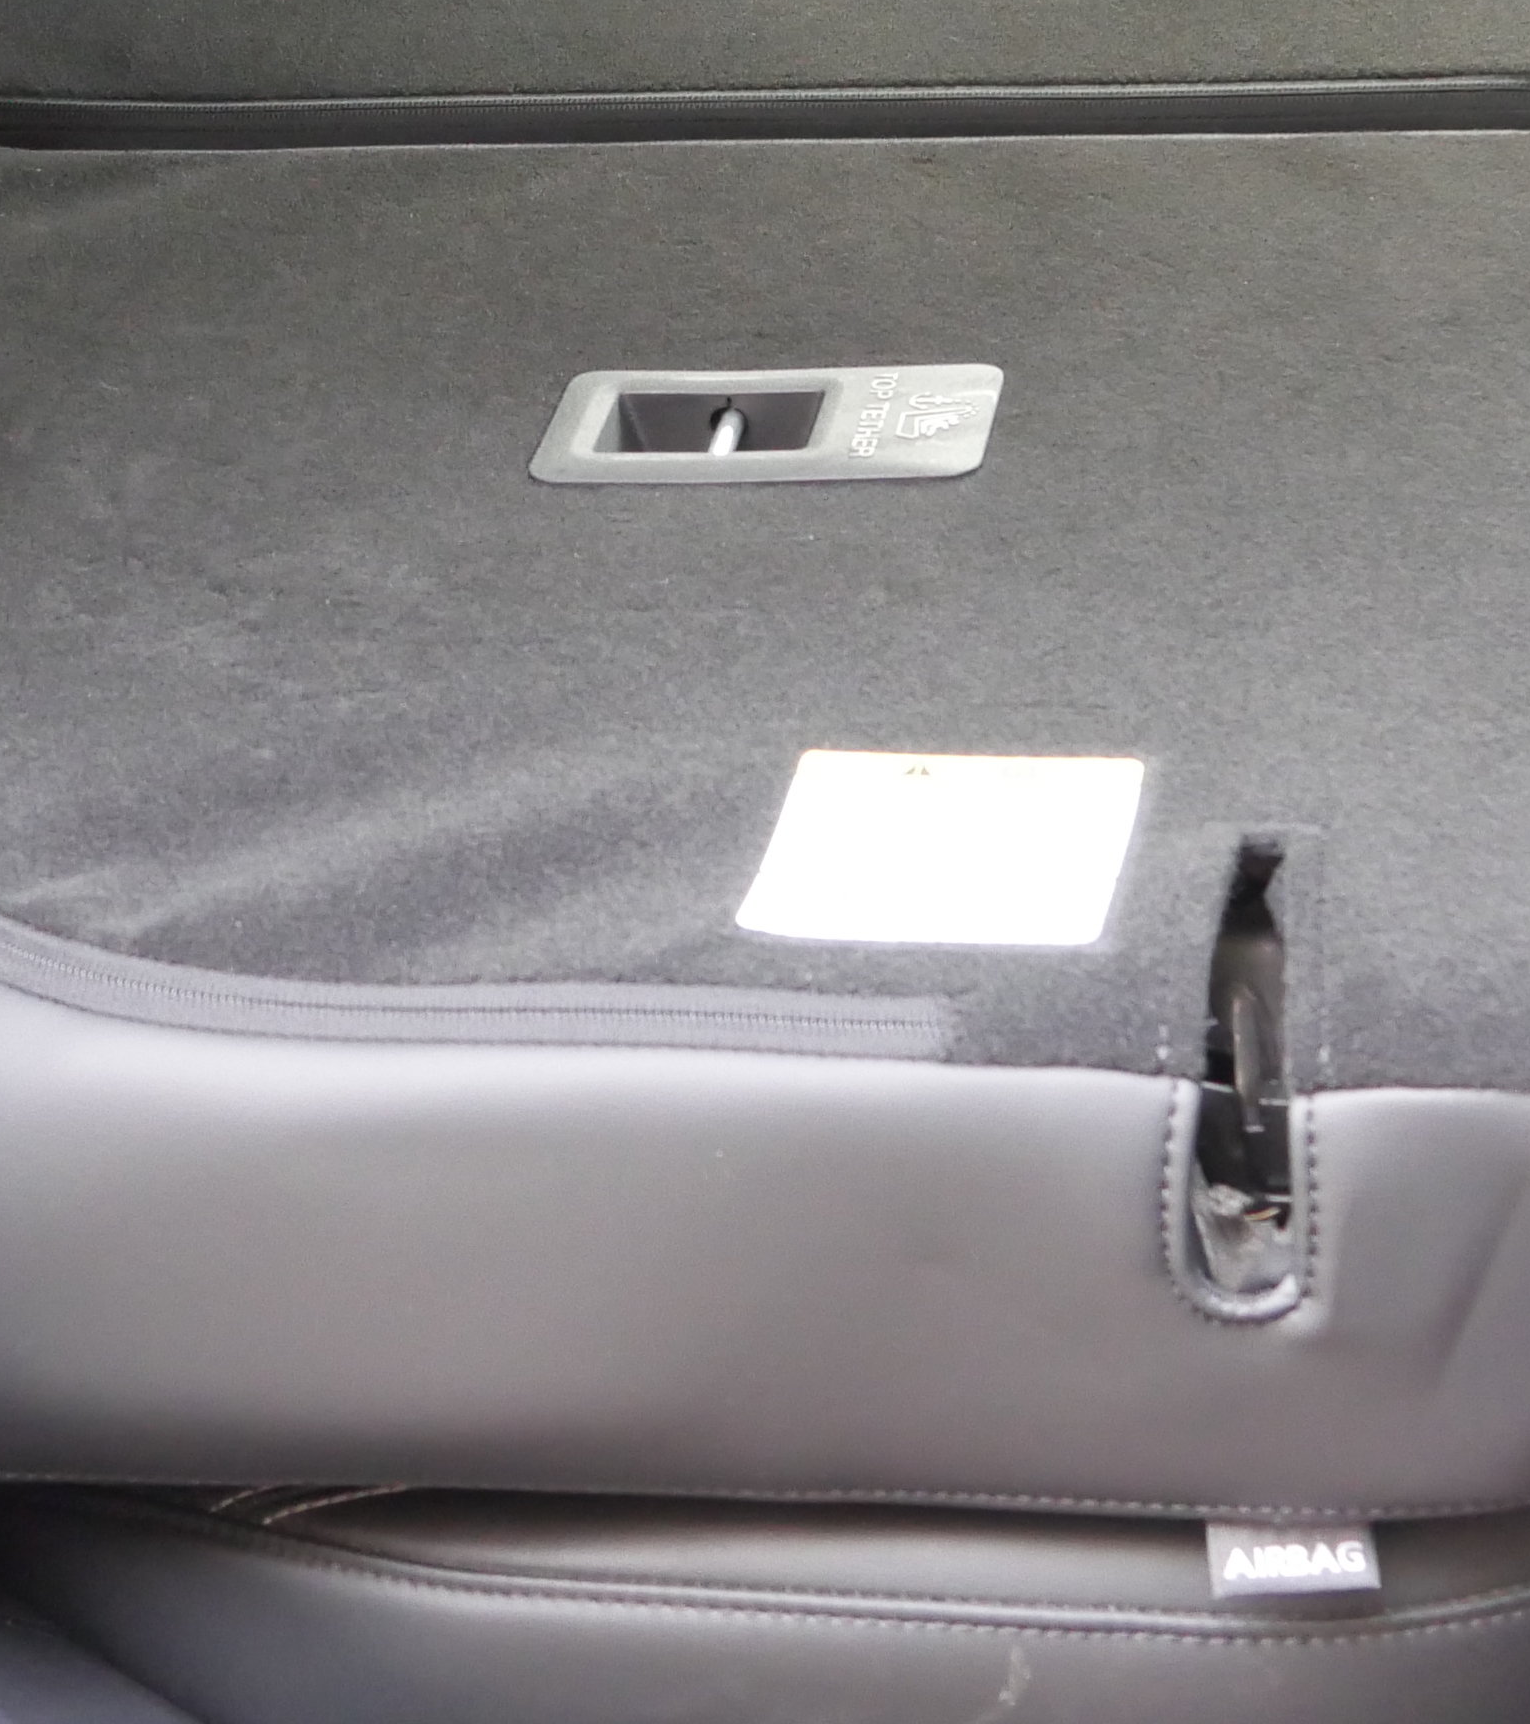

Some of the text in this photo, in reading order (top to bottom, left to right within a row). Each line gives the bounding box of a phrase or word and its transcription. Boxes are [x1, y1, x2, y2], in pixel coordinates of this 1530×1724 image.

[850, 372, 899, 458] TOP TETHER
[1223, 1540, 1367, 1580] AIRBAG
